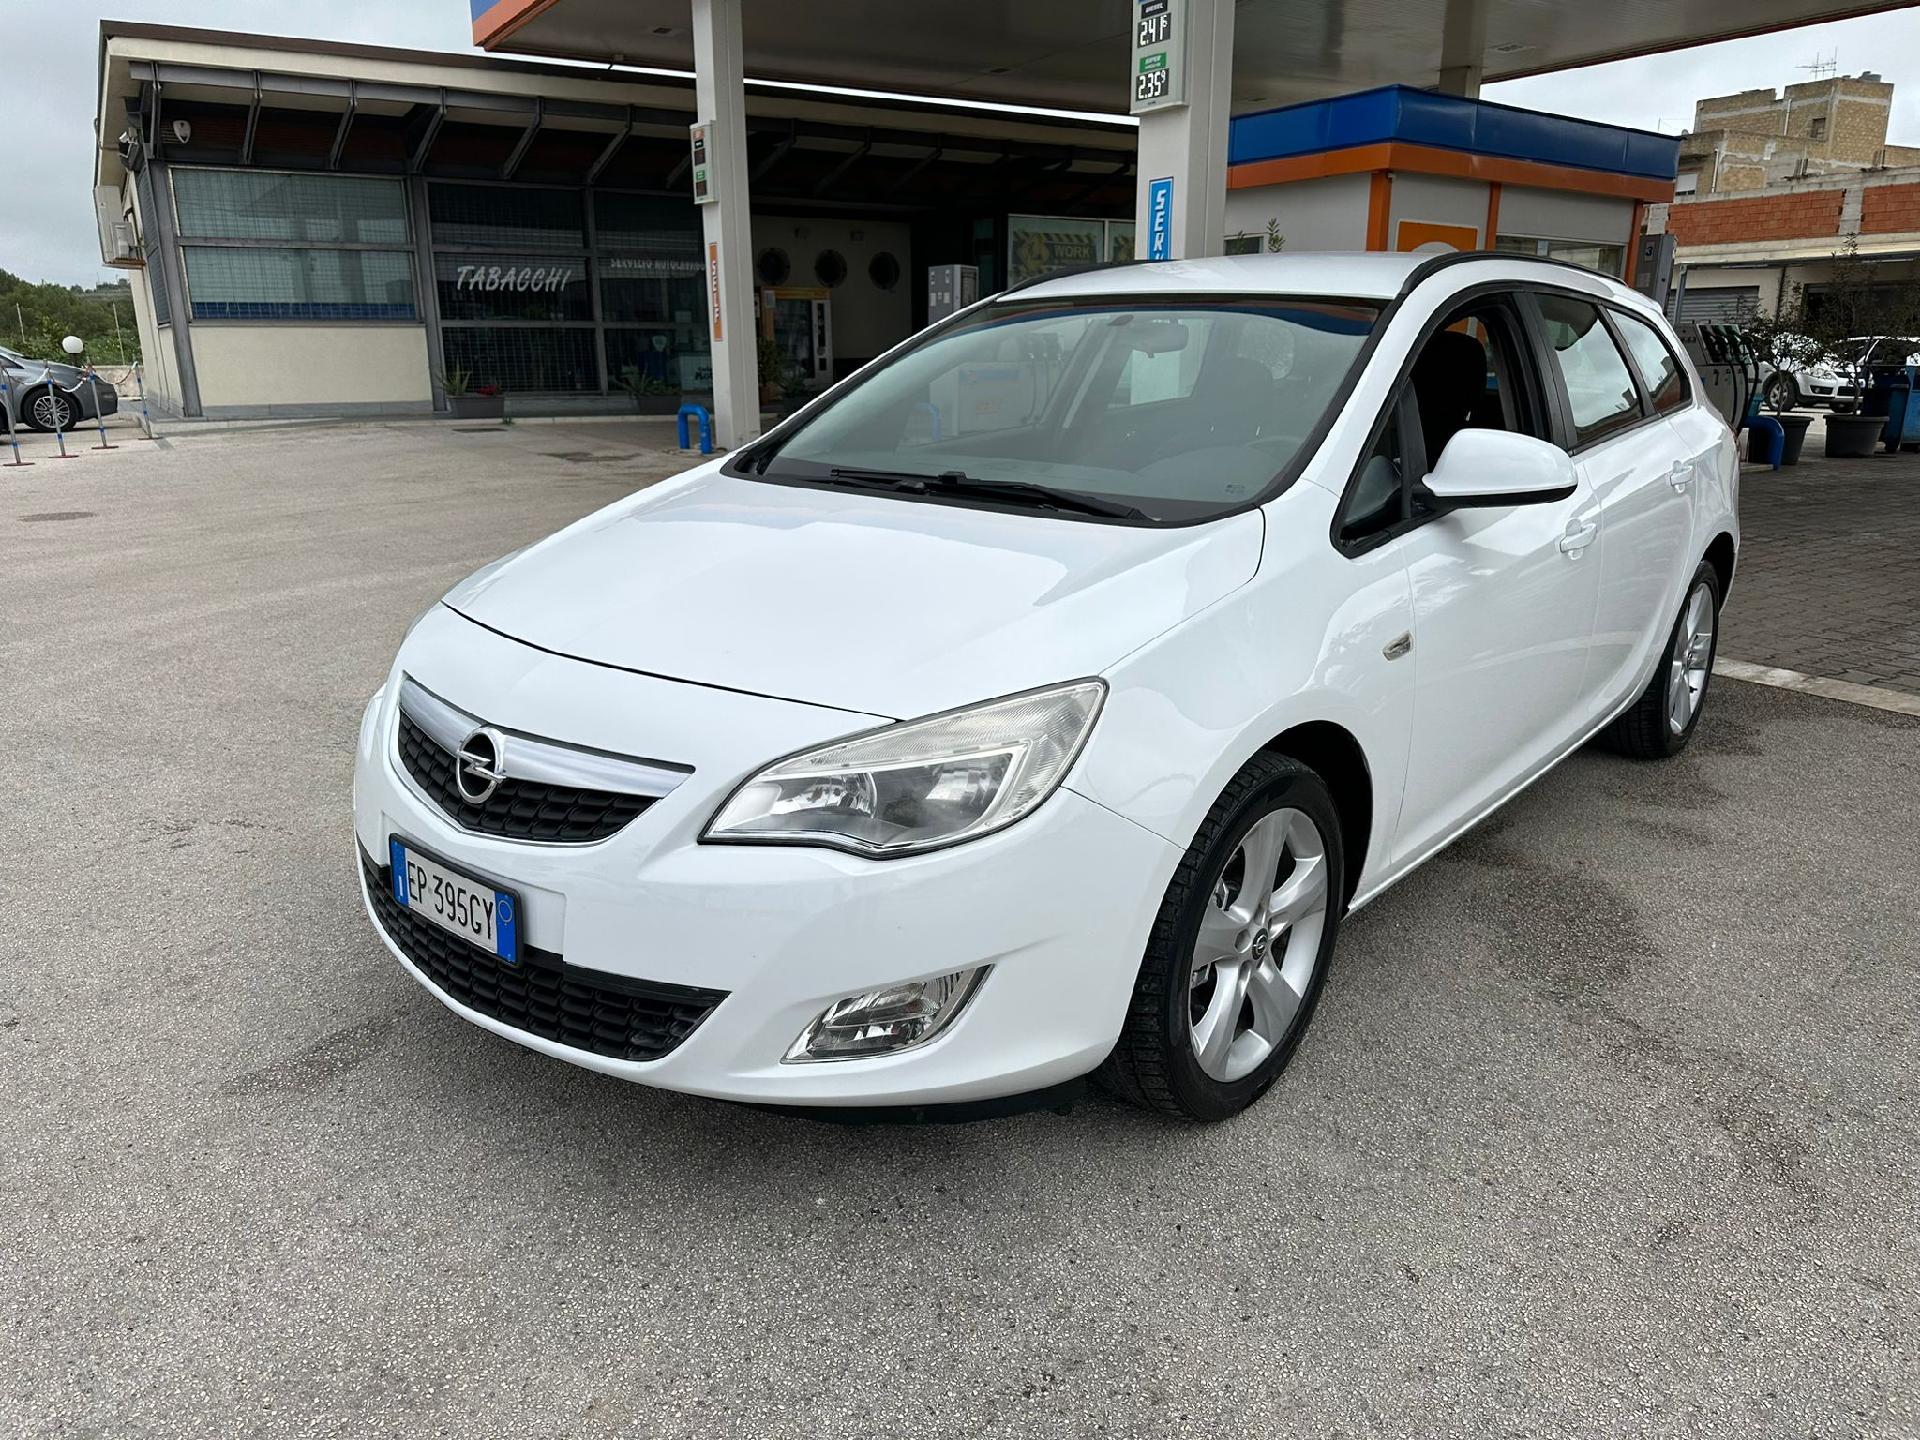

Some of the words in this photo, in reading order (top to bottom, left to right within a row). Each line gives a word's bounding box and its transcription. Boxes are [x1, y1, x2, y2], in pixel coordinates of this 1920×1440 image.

[1138, 70, 1165, 99] 2.359
[1054, 244, 1090, 259] WORK
[1646, 246, 1653, 256] 3
[457, 265, 572, 292] TABACCHI
